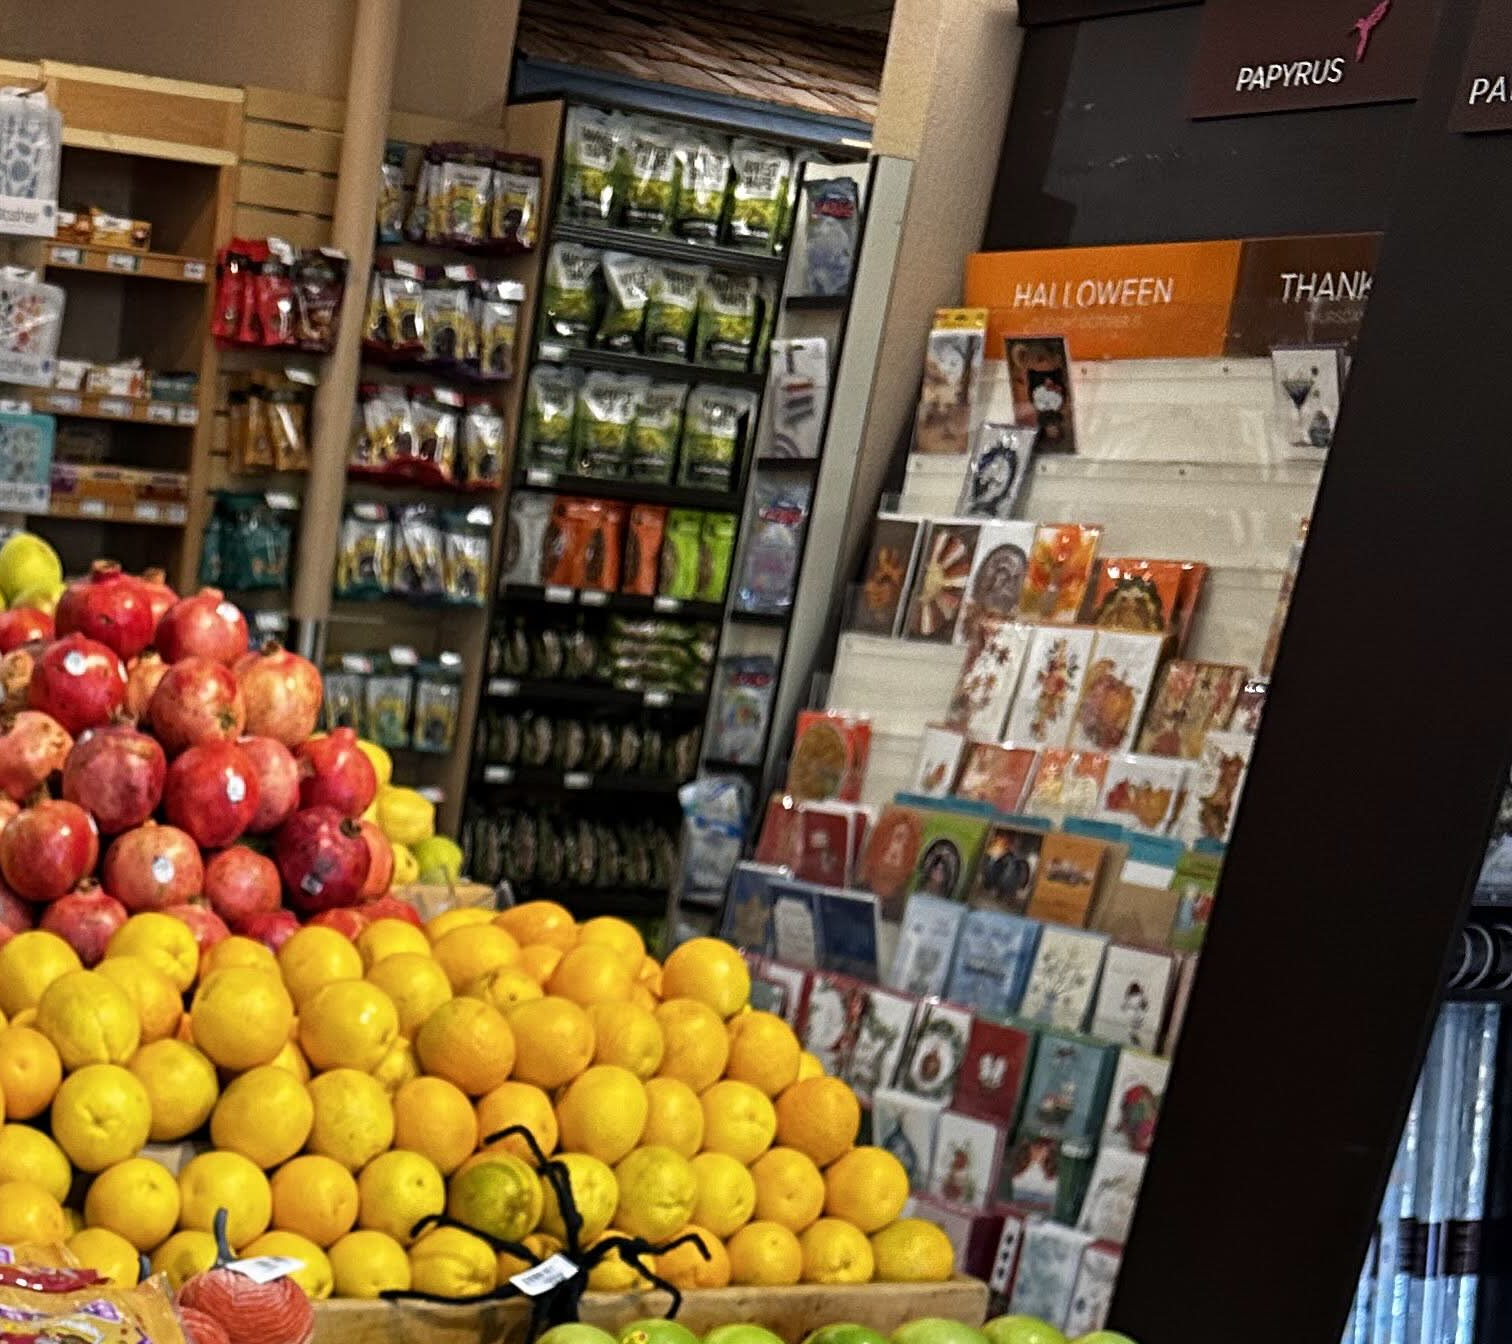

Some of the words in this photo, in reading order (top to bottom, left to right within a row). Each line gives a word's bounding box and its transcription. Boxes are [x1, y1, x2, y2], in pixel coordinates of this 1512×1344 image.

[1235, 56, 1346, 92] PAPYRUS
[1468, 74, 1512, 106] PA
[1012, 277, 1175, 309] HALLOWEEN
